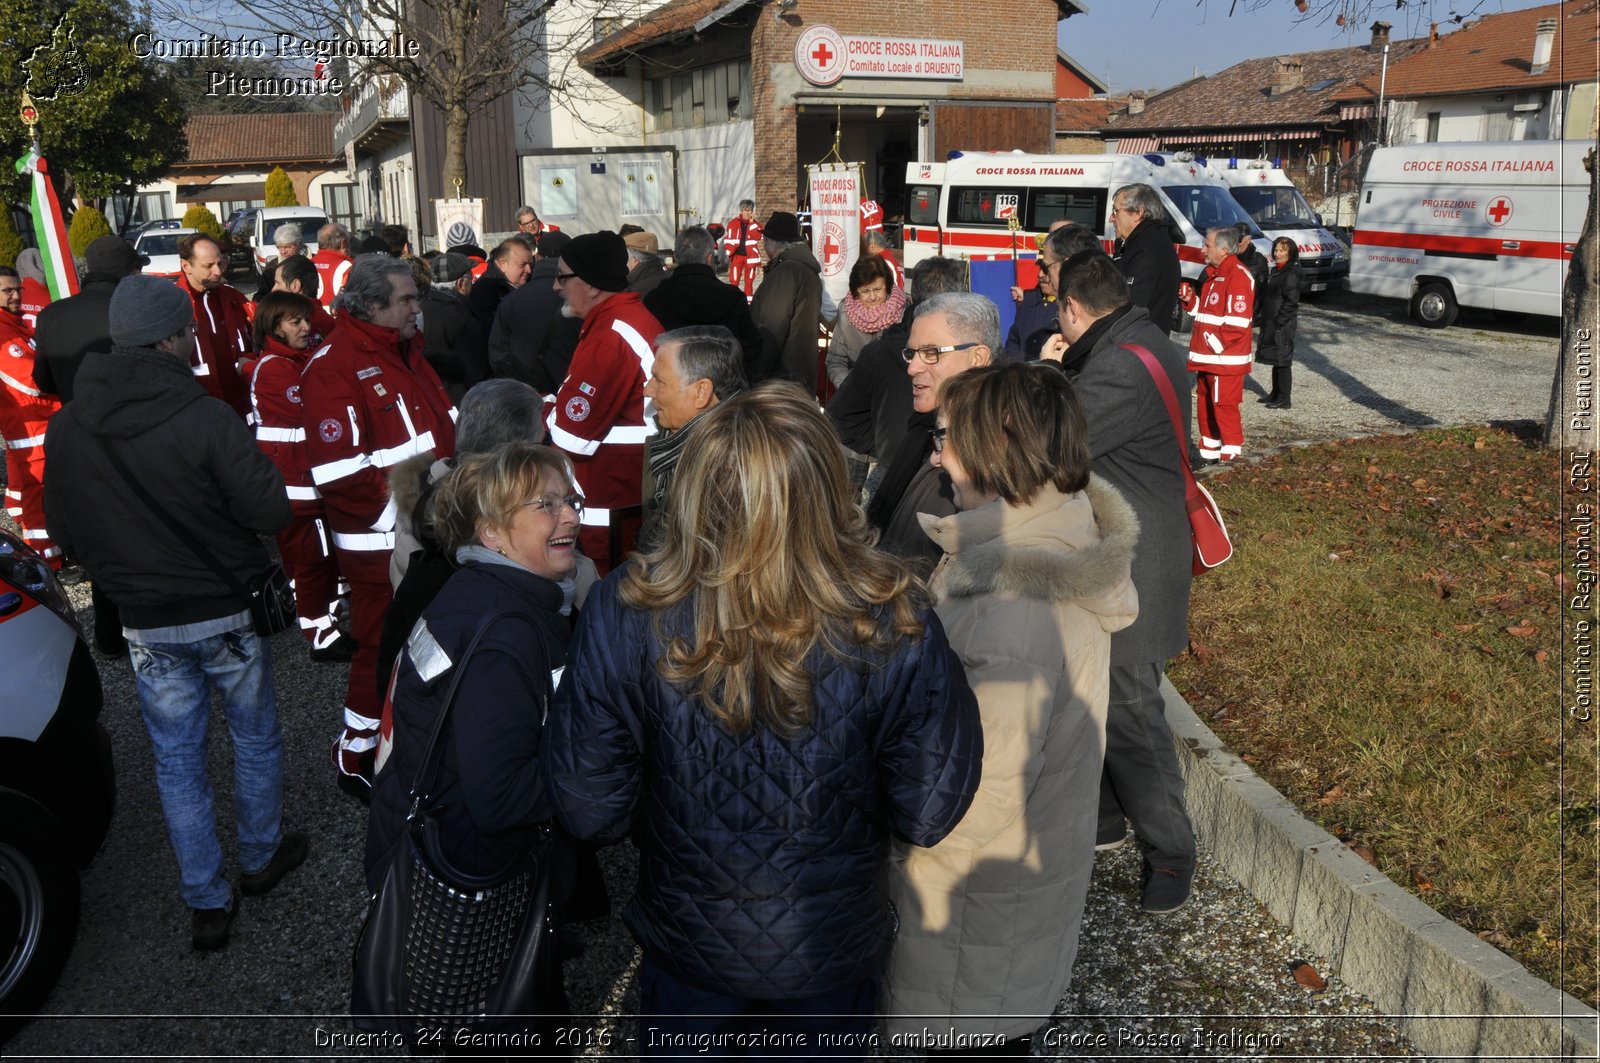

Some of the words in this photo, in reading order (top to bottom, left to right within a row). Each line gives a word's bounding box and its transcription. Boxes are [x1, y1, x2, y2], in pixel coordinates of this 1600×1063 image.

[849, 40, 882, 55] CROCE
[885, 42, 916, 56] ROSSA
[920, 43, 960, 58] ITALIANA
[850, 60, 884, 72] Comitato
[888, 61, 912, 73] Locale
[915, 62, 922, 73] di
[924, 62, 960, 74] DRUENTO
[1403, 161, 1441, 172] CROCE
[1446, 161, 1487, 172] ROSSA
[1491, 160, 1554, 172] ITALIANA
[1000, 196, 1017, 206] 118
[1422, 200, 1476, 209] PROTEZIONE
[1433, 210, 1461, 219] CIVILE
[1368, 255, 1395, 263] OFFICINA
